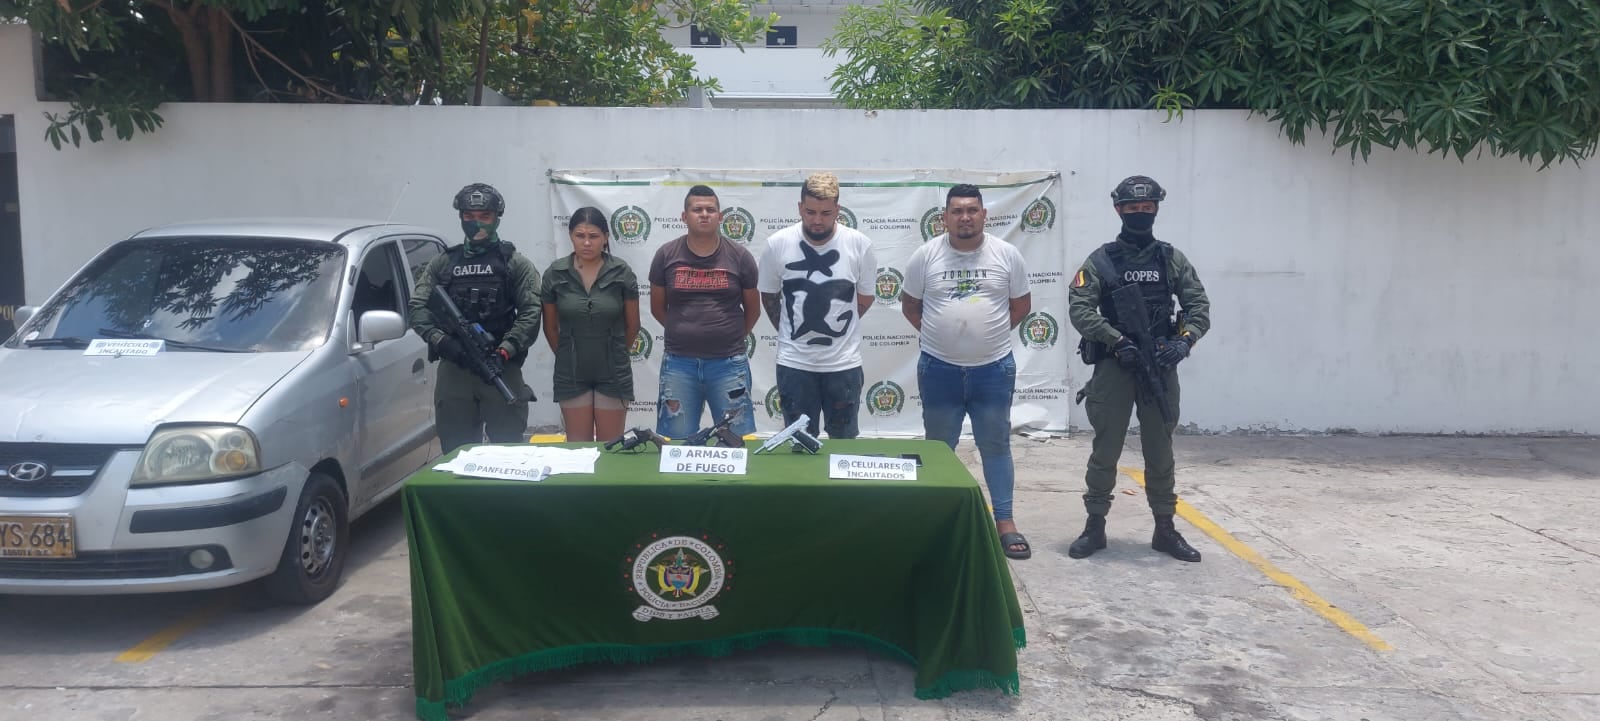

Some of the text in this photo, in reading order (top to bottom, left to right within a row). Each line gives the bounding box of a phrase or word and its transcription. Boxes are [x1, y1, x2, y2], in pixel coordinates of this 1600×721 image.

[453, 264, 493, 277] GAULA
[942, 269, 987, 280] JORDAN
[1124, 270, 1160, 282] COPES
[686, 449, 728, 459] ARMAS
[476, 464, 527, 476] PANFLETOS
[676, 462, 735, 473] DE FUEGO
[851, 460, 901, 470] CELULARES
[847, 470, 905, 480] INCAUTADOS
[29, 523, 70, 548] 684
